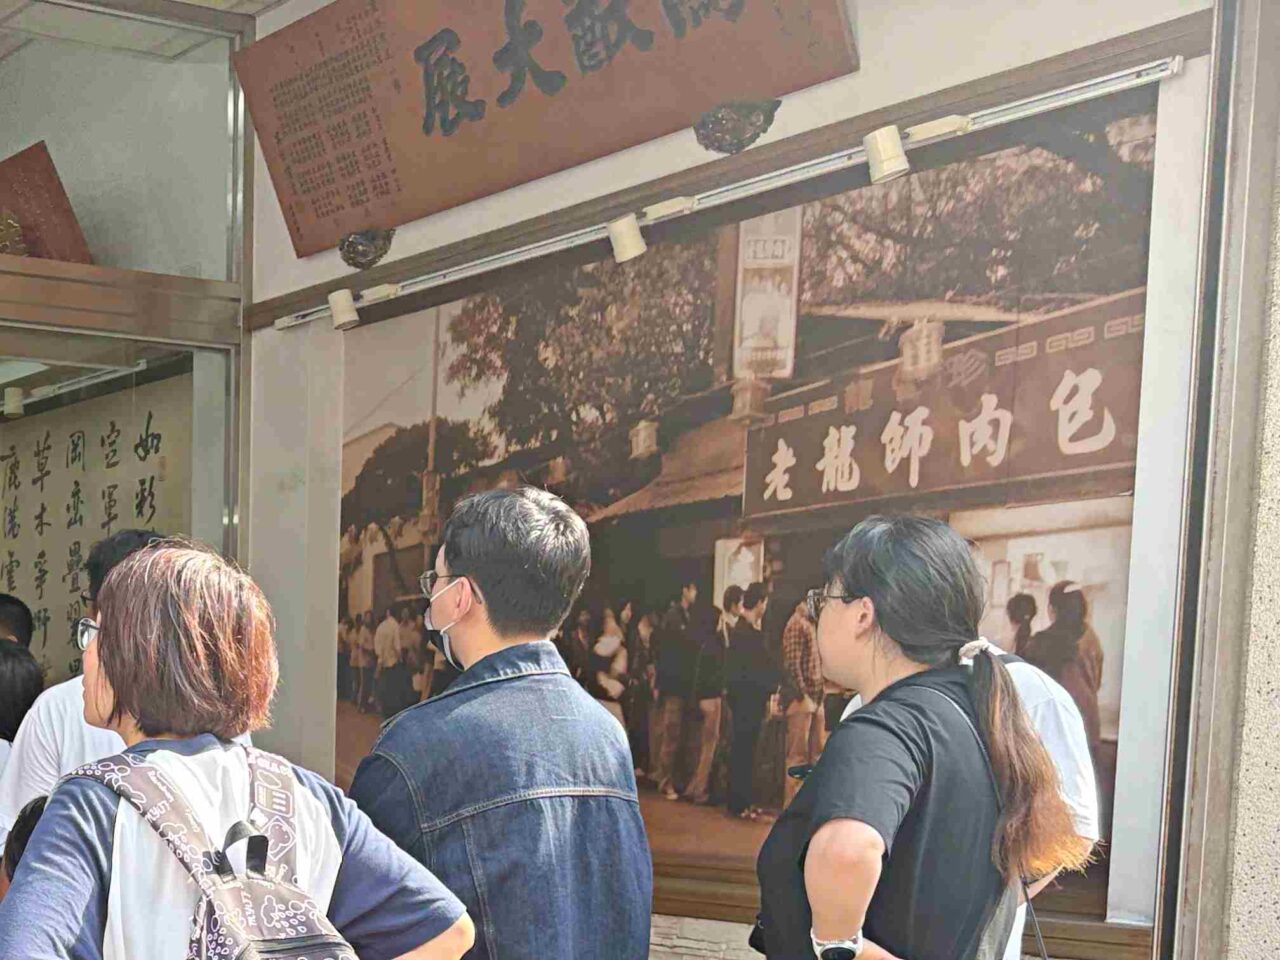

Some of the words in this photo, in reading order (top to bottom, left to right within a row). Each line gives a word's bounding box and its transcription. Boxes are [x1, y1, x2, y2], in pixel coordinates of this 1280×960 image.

[763, 367, 1116, 500] 老龍師肉包
